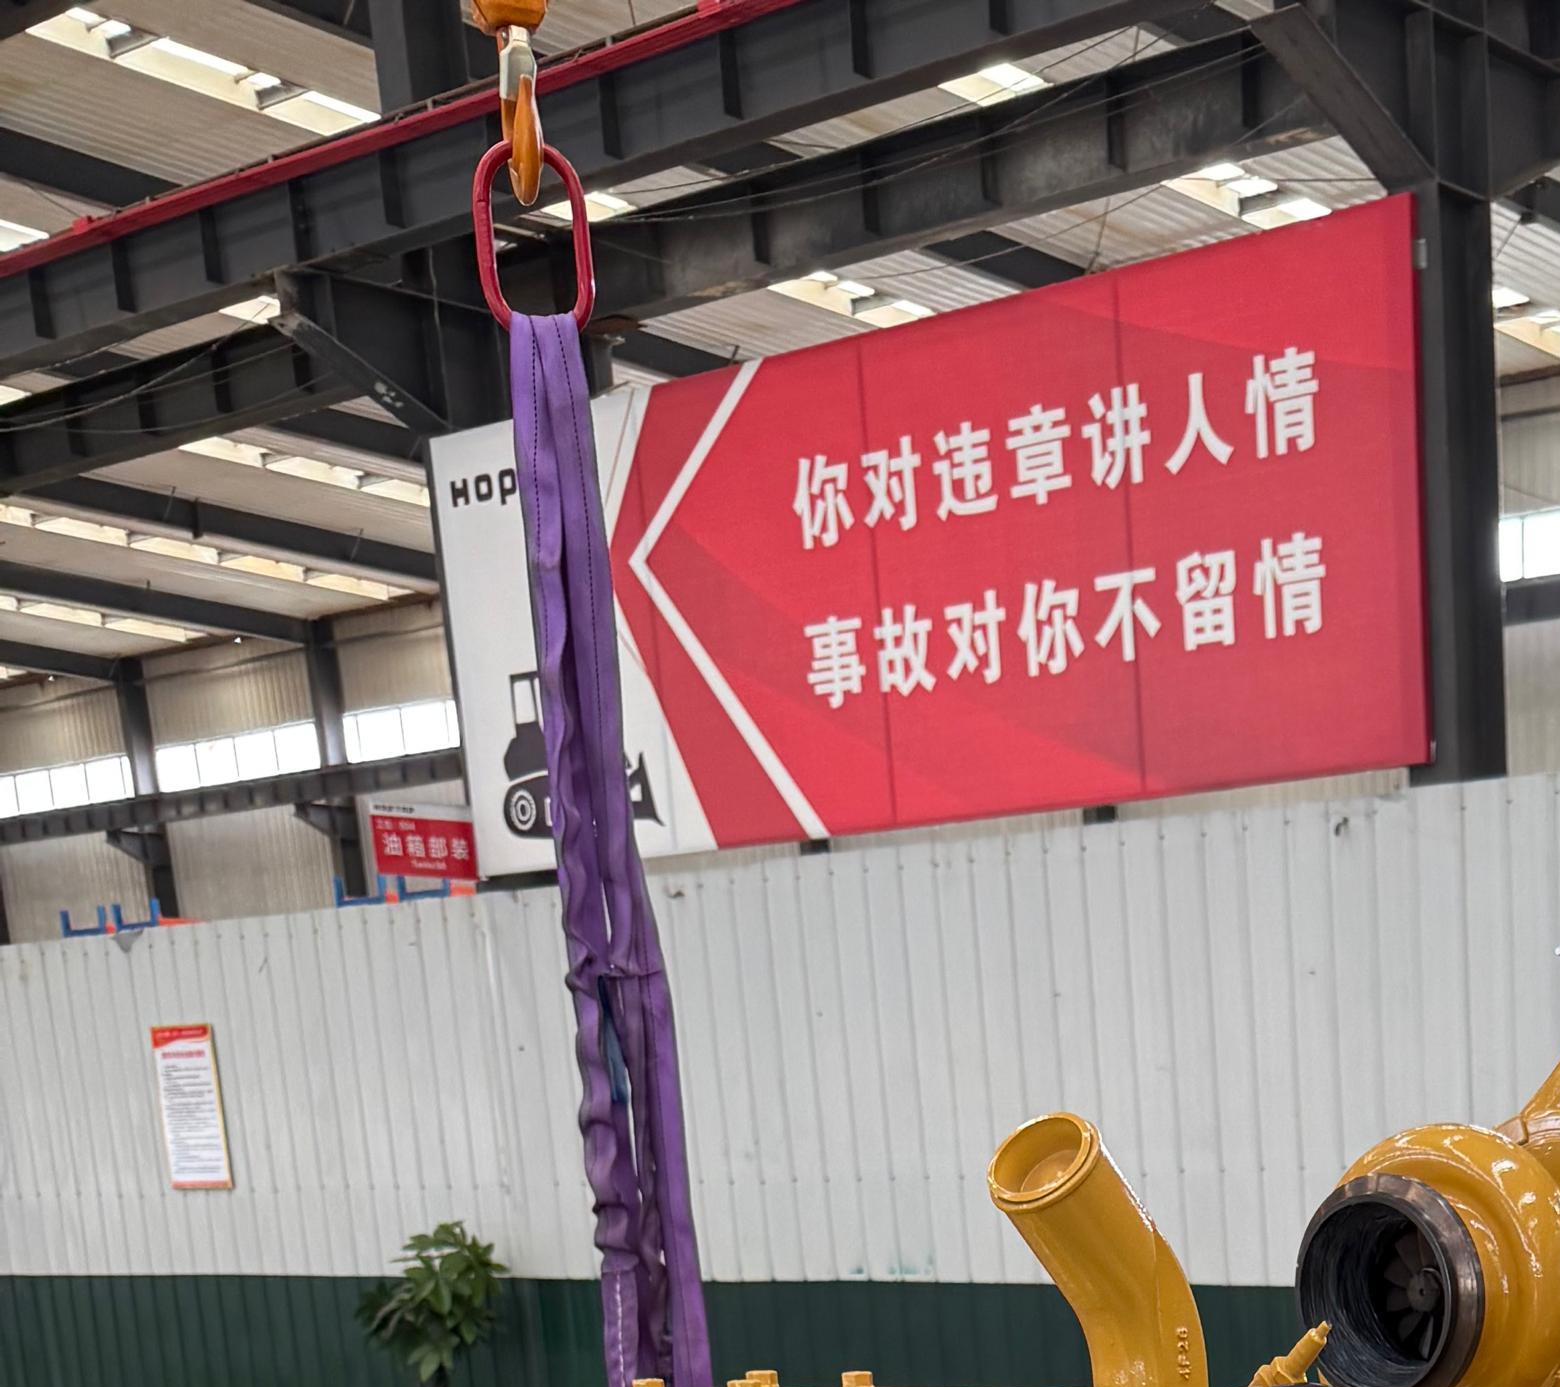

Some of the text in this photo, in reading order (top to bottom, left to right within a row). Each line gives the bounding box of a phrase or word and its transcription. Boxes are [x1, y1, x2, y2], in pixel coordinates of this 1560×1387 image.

[793, 347, 1319, 549] 你对违章讲人情
[805, 532, 1326, 709] 事故对你不留情
